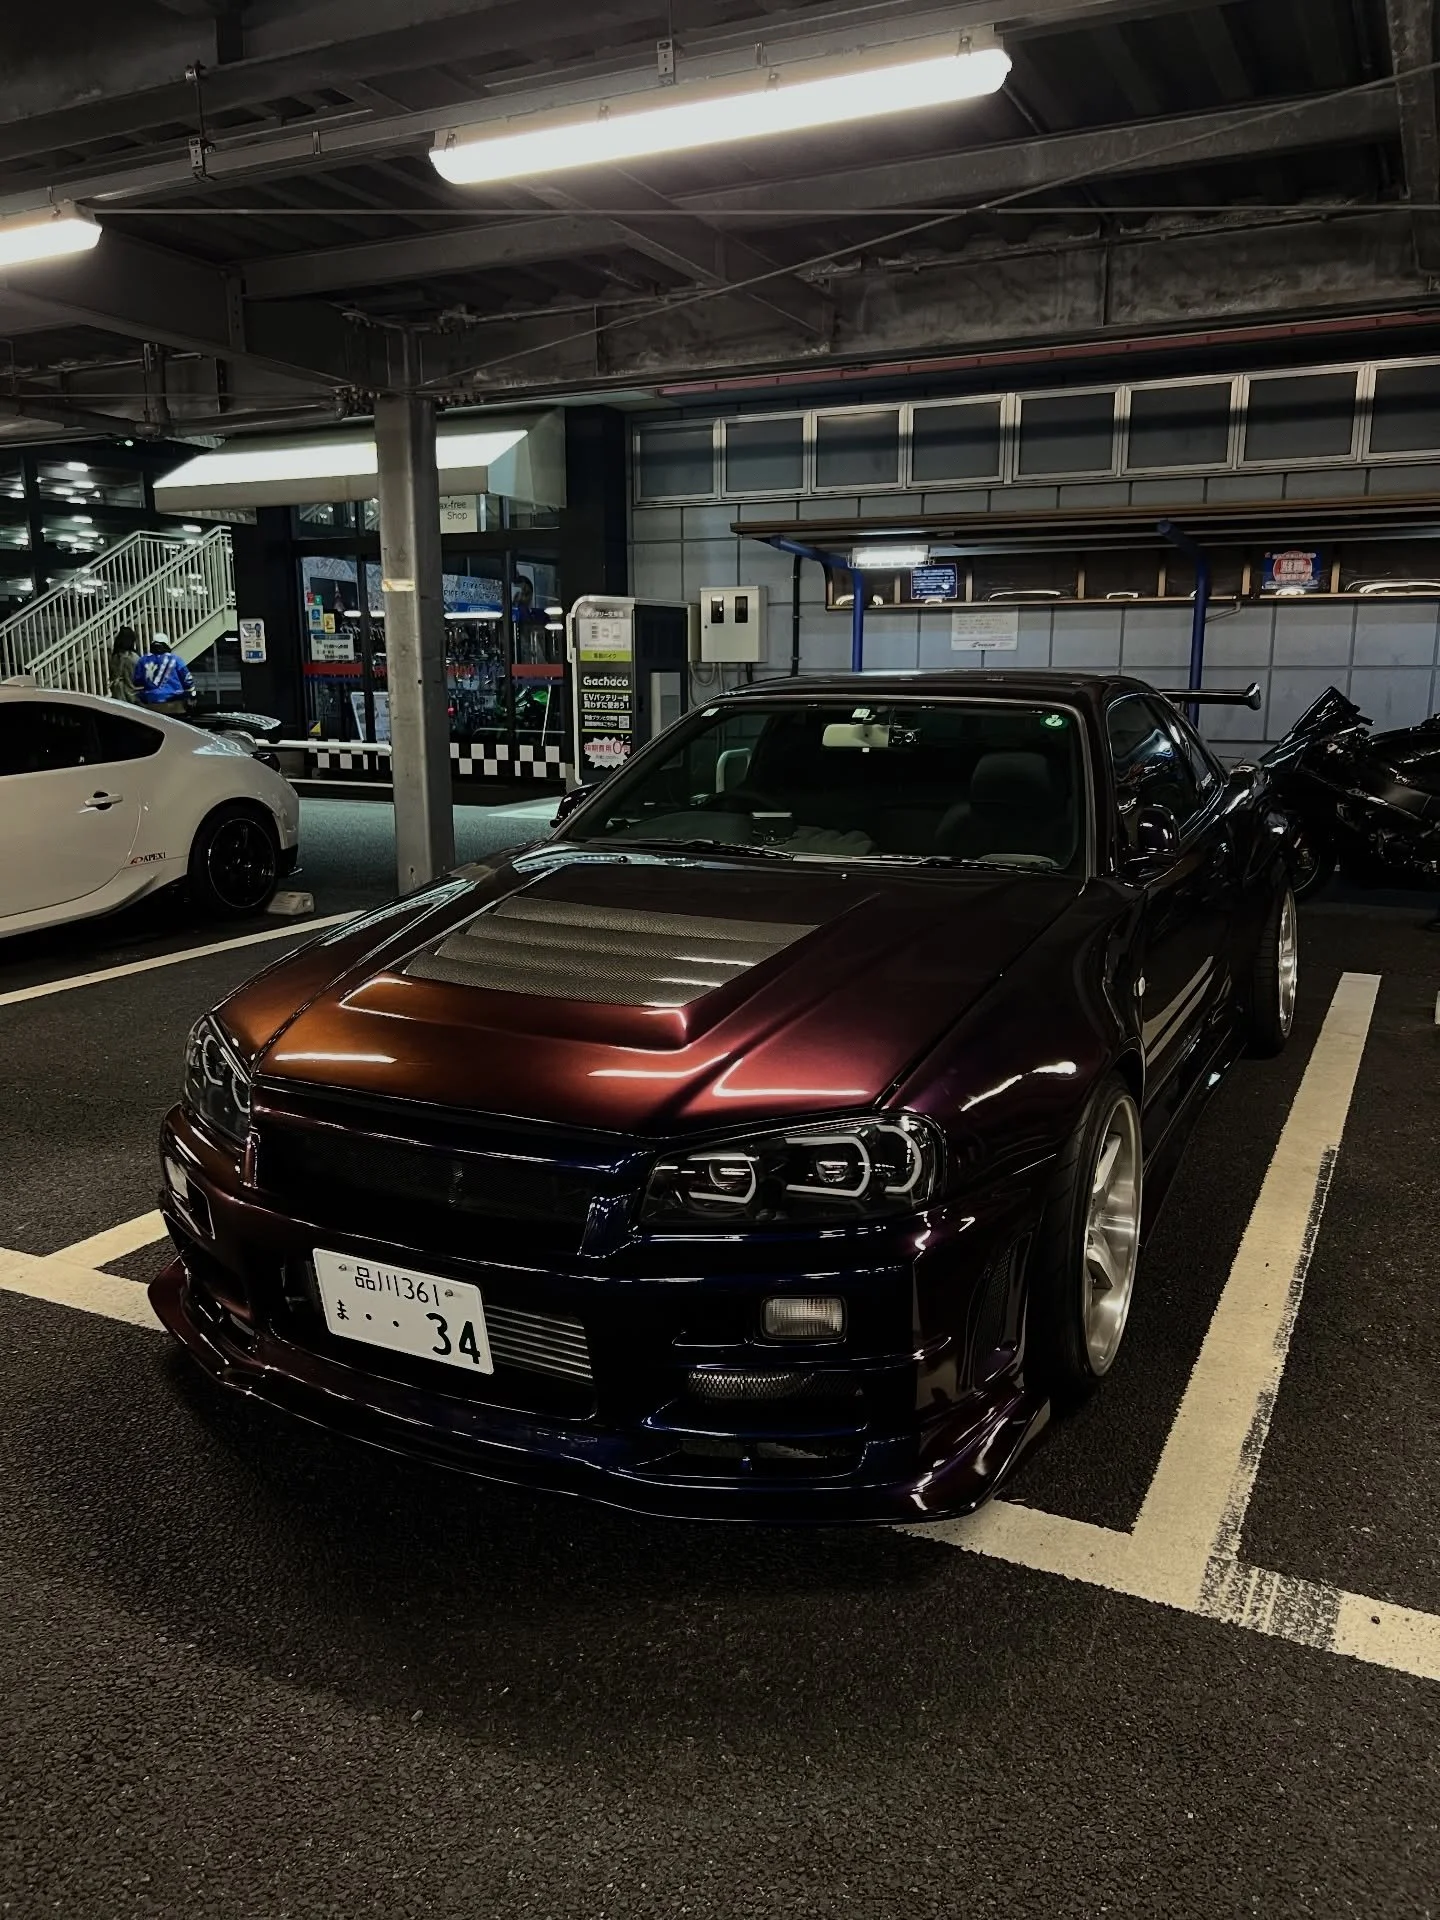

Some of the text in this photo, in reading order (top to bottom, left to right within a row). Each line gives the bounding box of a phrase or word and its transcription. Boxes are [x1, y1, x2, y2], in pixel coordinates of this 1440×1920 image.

[447, 511, 468, 520] Shop
[583, 676, 629, 687] Gachaco
[336, 1299, 481, 1365] ま 34
